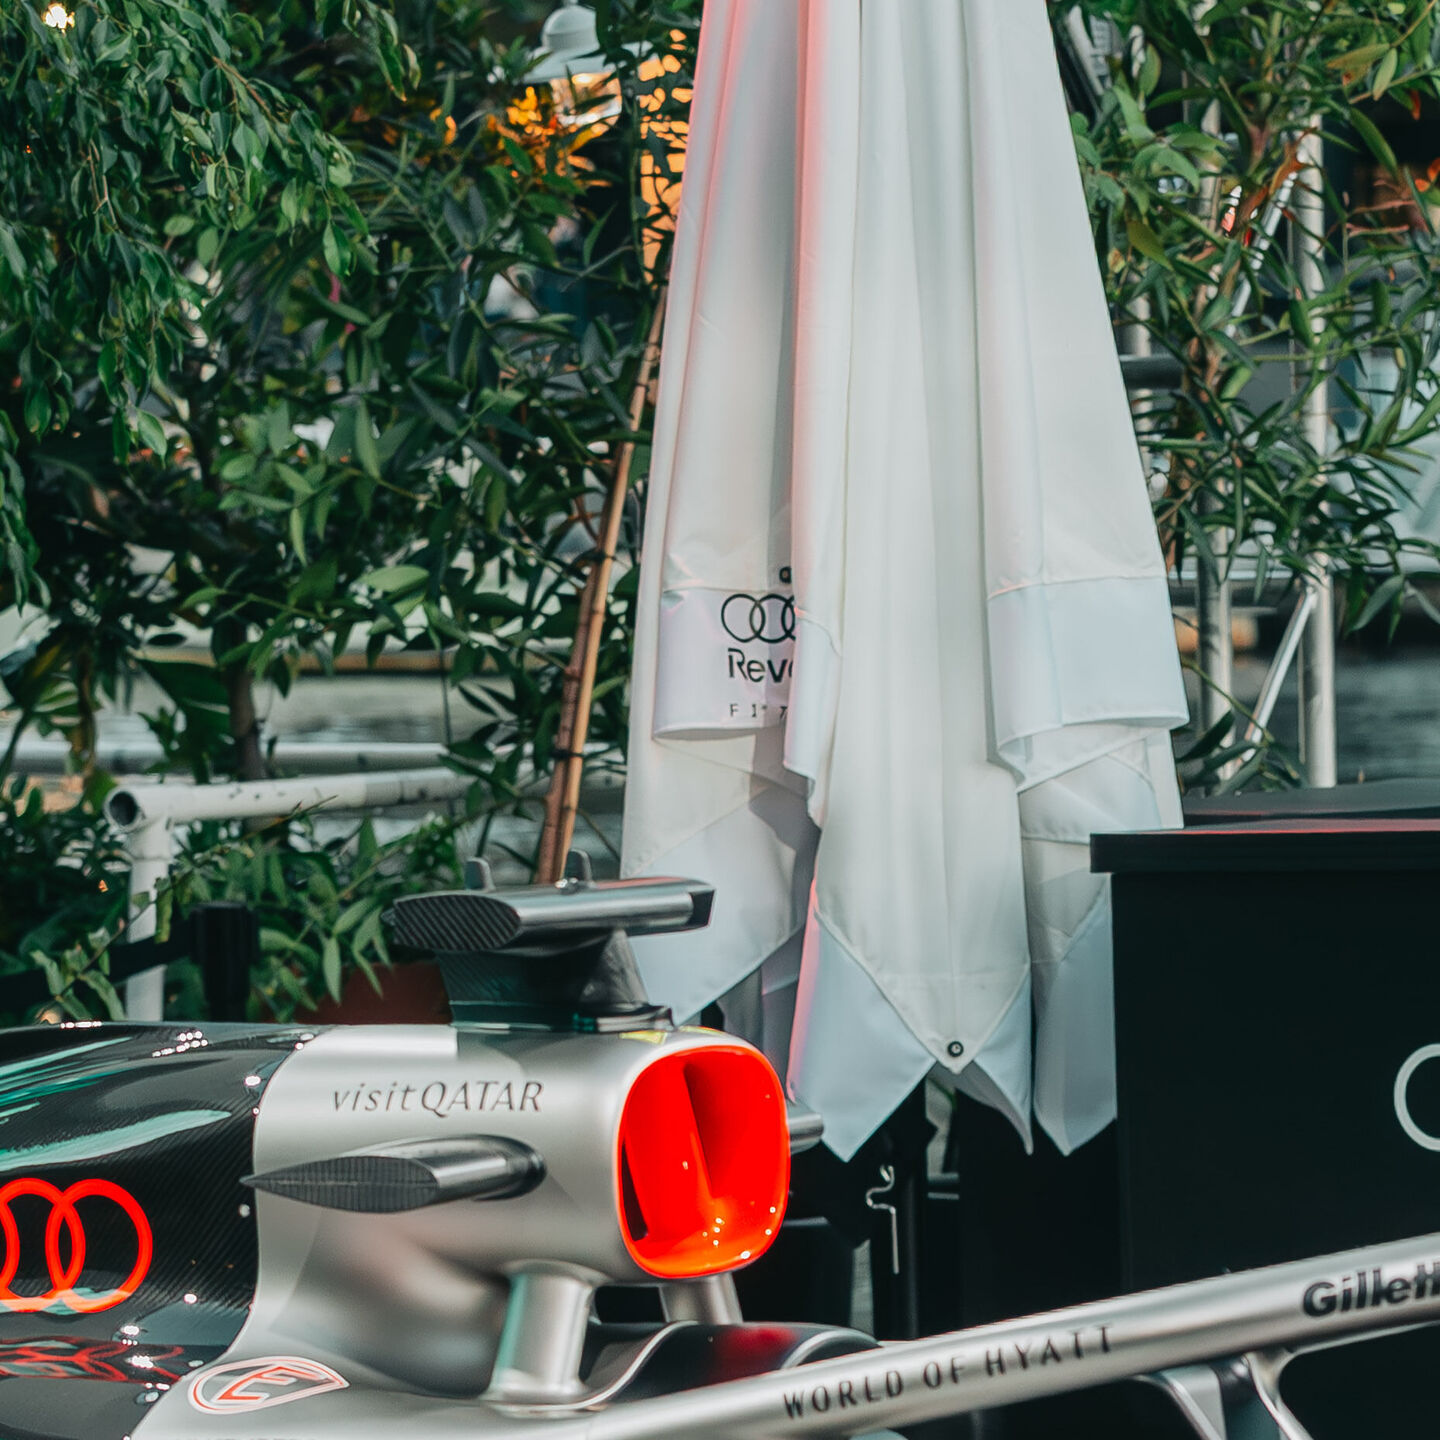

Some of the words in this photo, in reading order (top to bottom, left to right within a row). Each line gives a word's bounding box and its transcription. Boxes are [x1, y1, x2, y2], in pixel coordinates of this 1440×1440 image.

[727, 647, 794, 683] Rev
[782, 1369, 904, 1419] WORLD
[923, 1356, 965, 1389] OF
[985, 1324, 1113, 1377] HYATT
